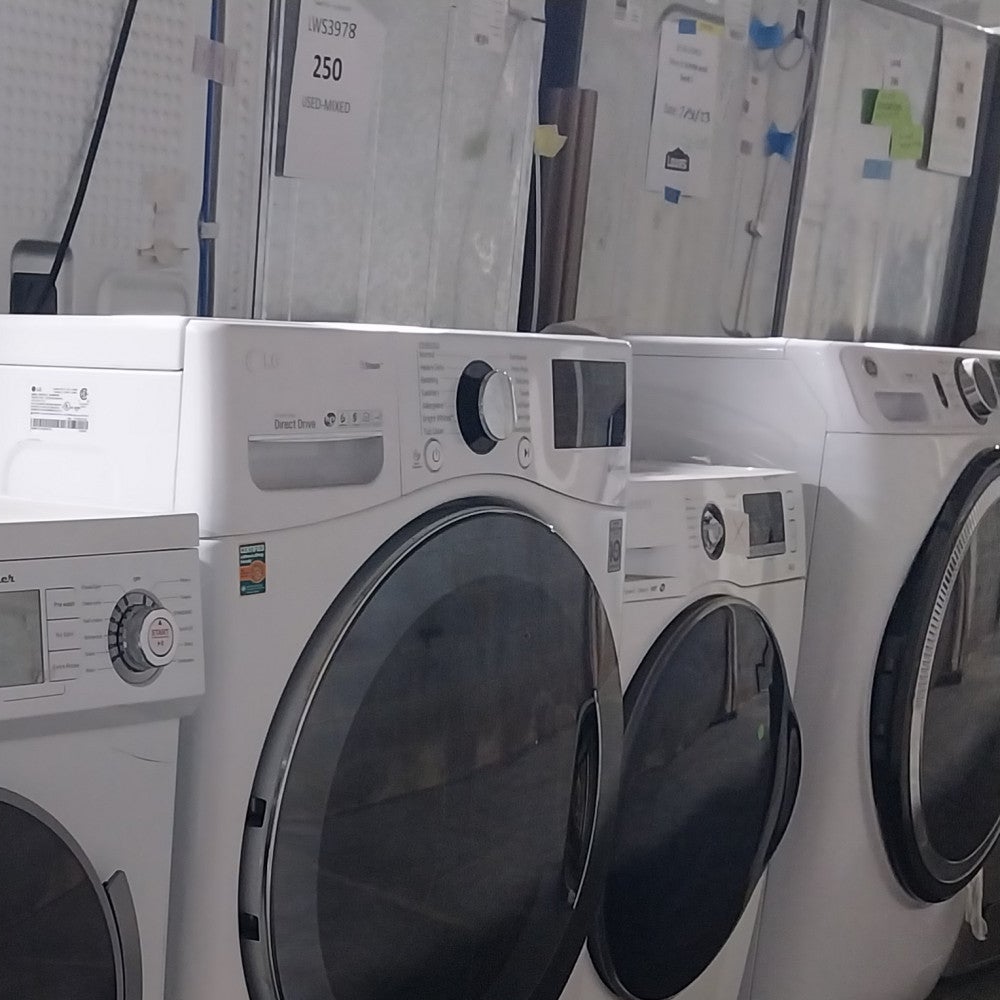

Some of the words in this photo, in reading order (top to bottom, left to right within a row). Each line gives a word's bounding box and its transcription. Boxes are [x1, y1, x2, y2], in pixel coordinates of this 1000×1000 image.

[307, 16, 358, 39] LWS3978
[312, 54, 343, 81] 250
[302, 95, 351, 114] USED-MIXED
[274, 418, 296, 430] Direct
[297, 418, 317, 429] Drive
